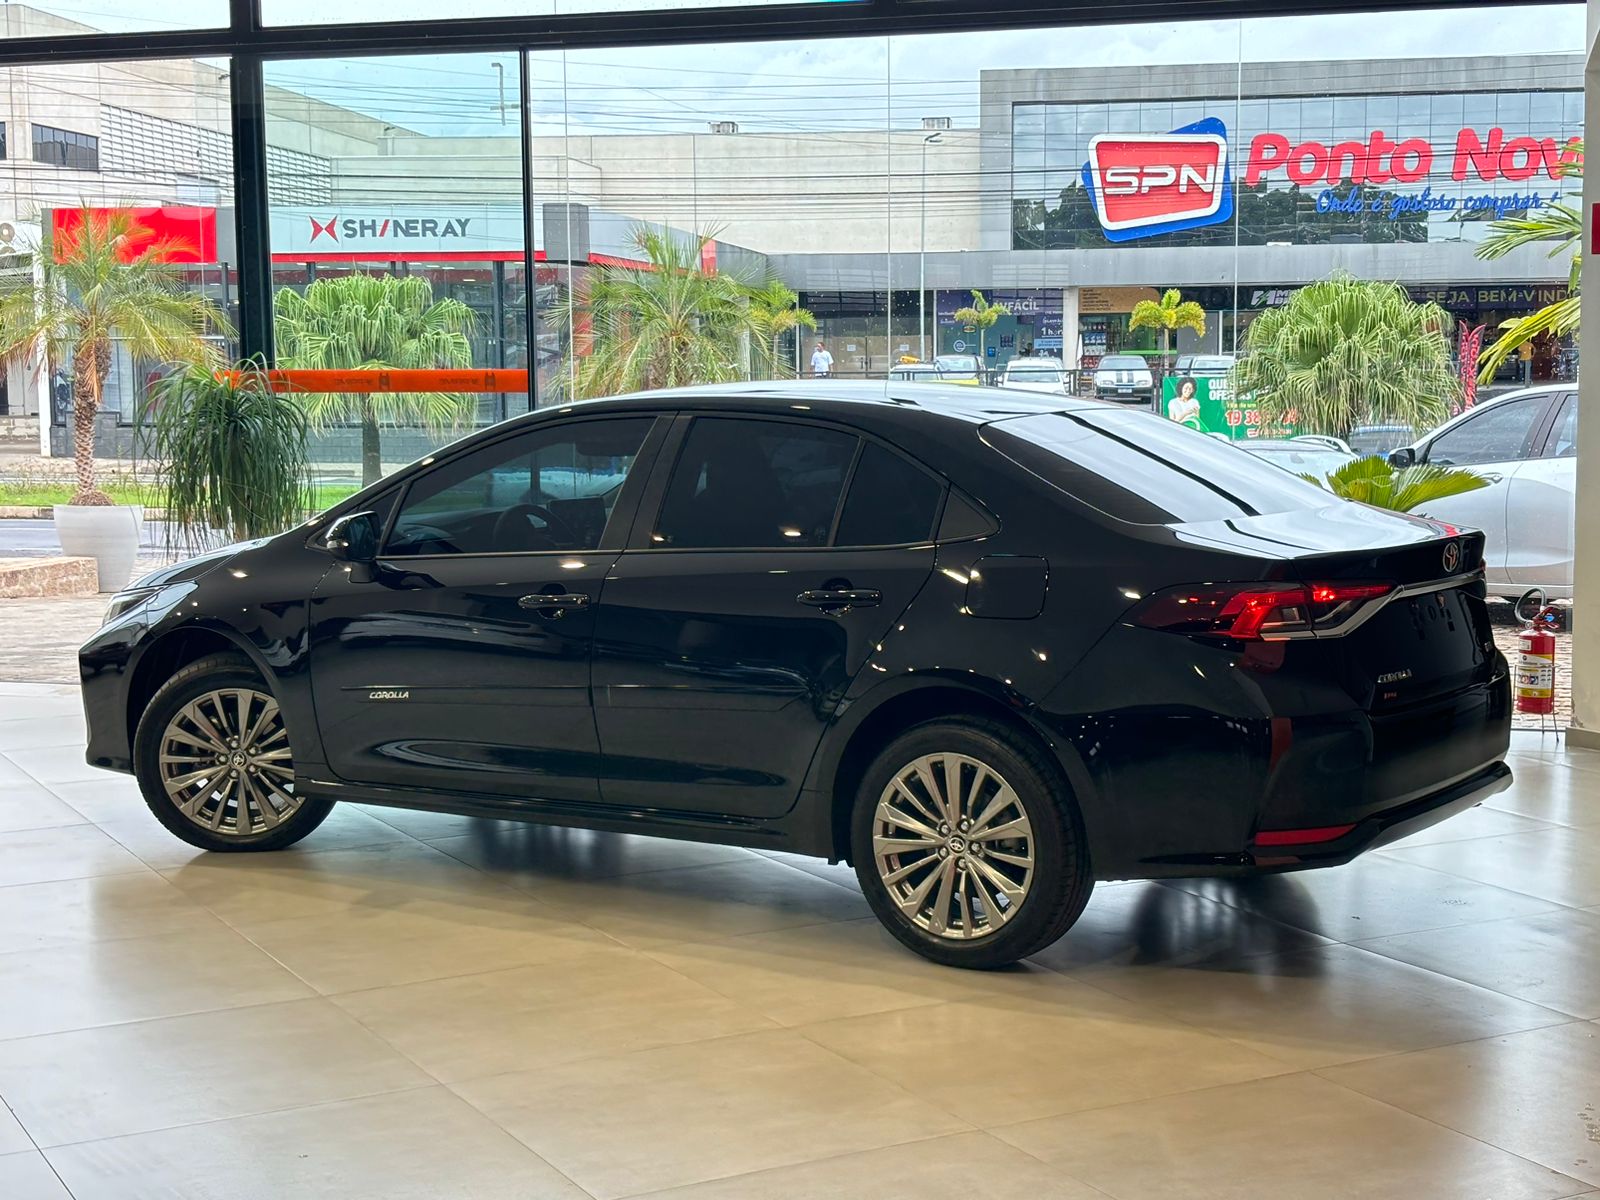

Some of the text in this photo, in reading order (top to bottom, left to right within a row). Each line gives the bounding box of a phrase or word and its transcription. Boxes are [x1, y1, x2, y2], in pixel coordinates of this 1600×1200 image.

[1245, 127, 1584, 187] Ponto Nov
[1104, 163, 1215, 195] SPN
[1316, 185, 1364, 213] Onde
[1387, 186, 1456, 219] gostoso
[1426, 290, 1470, 303] SEJA
[368, 691, 409, 699] COROLLA
